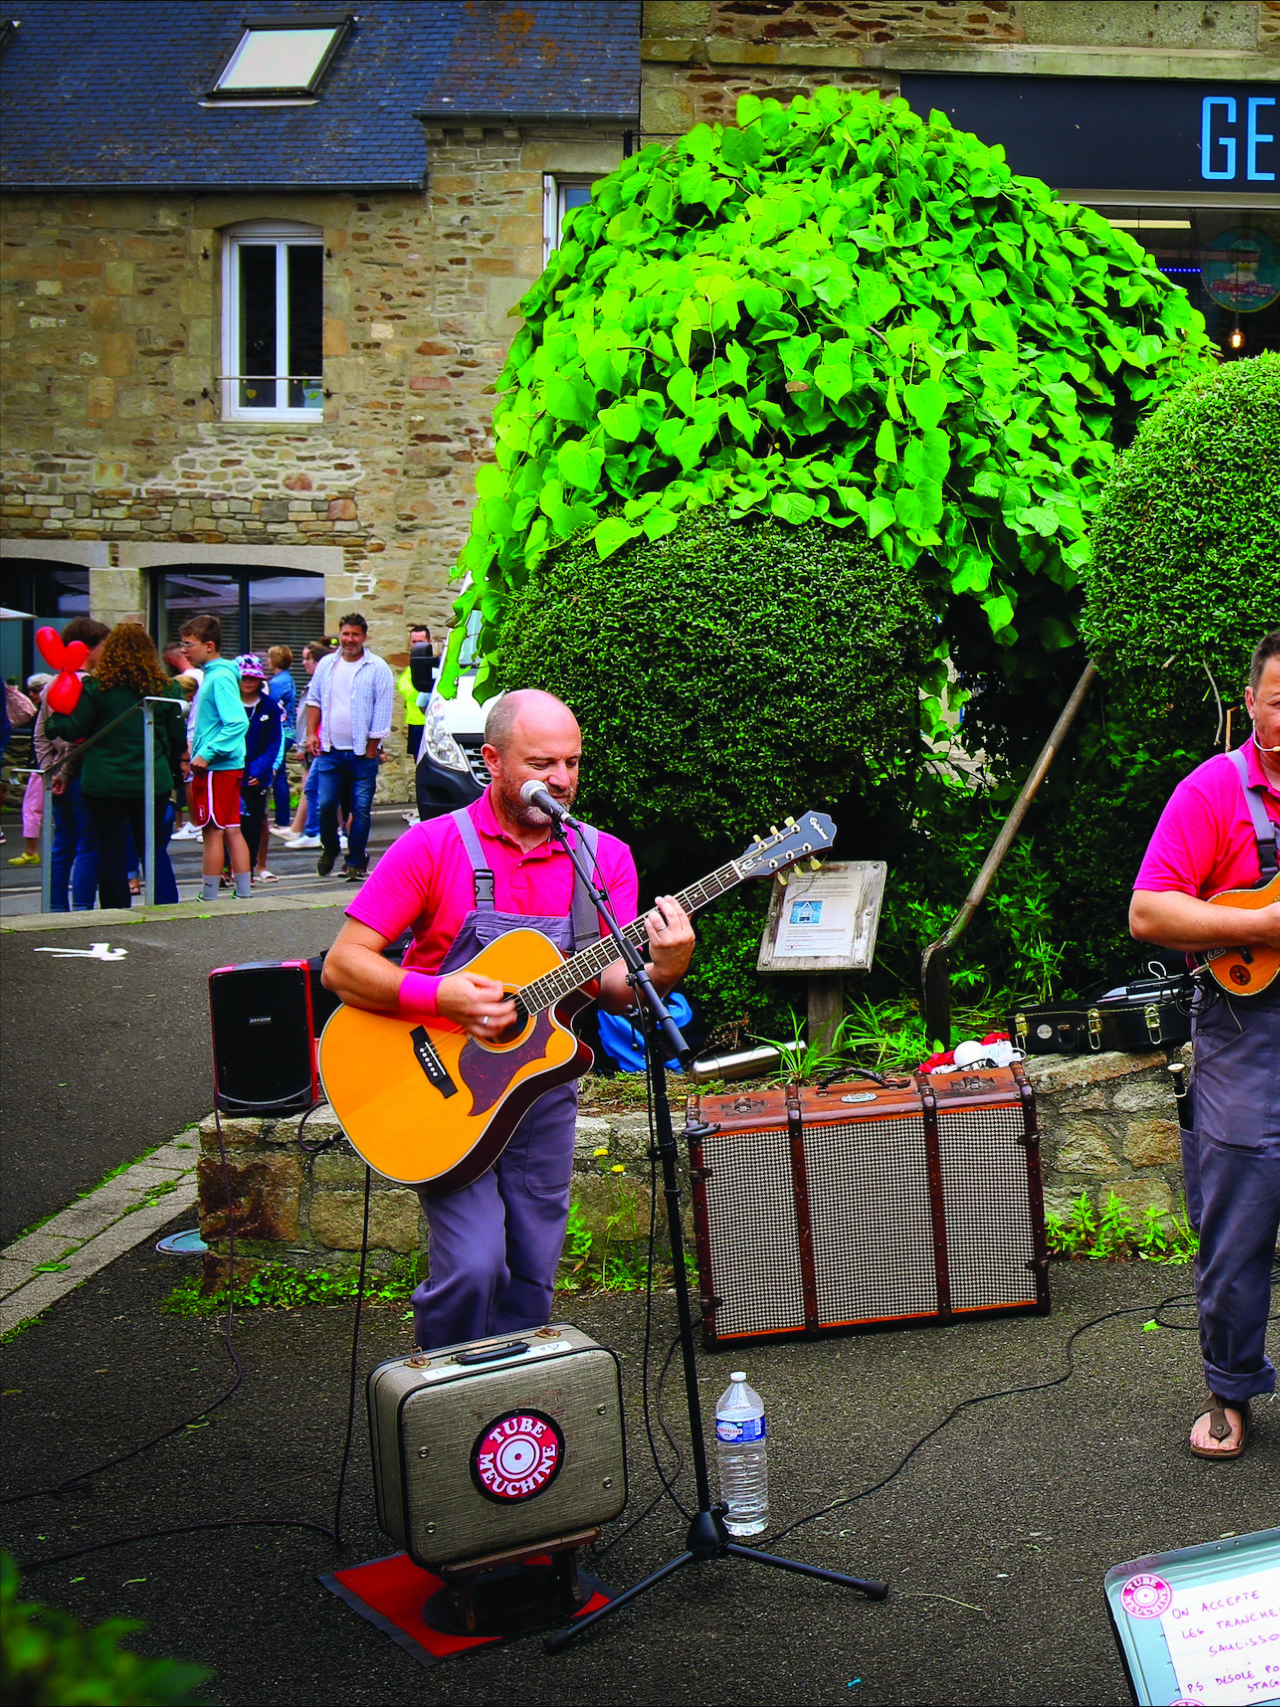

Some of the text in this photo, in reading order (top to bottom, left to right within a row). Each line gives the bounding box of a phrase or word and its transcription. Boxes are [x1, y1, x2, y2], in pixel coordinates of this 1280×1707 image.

[488, 1417, 547, 1444] TUBE
[479, 1444, 556, 1496] MEUCHINE
[1126, 1577, 1158, 1591] TUBE
[1172, 1607, 1189, 1620] ON
[1201, 1590, 1261, 1613] ACCEPTE
[1181, 1627, 1205, 1639] LES
